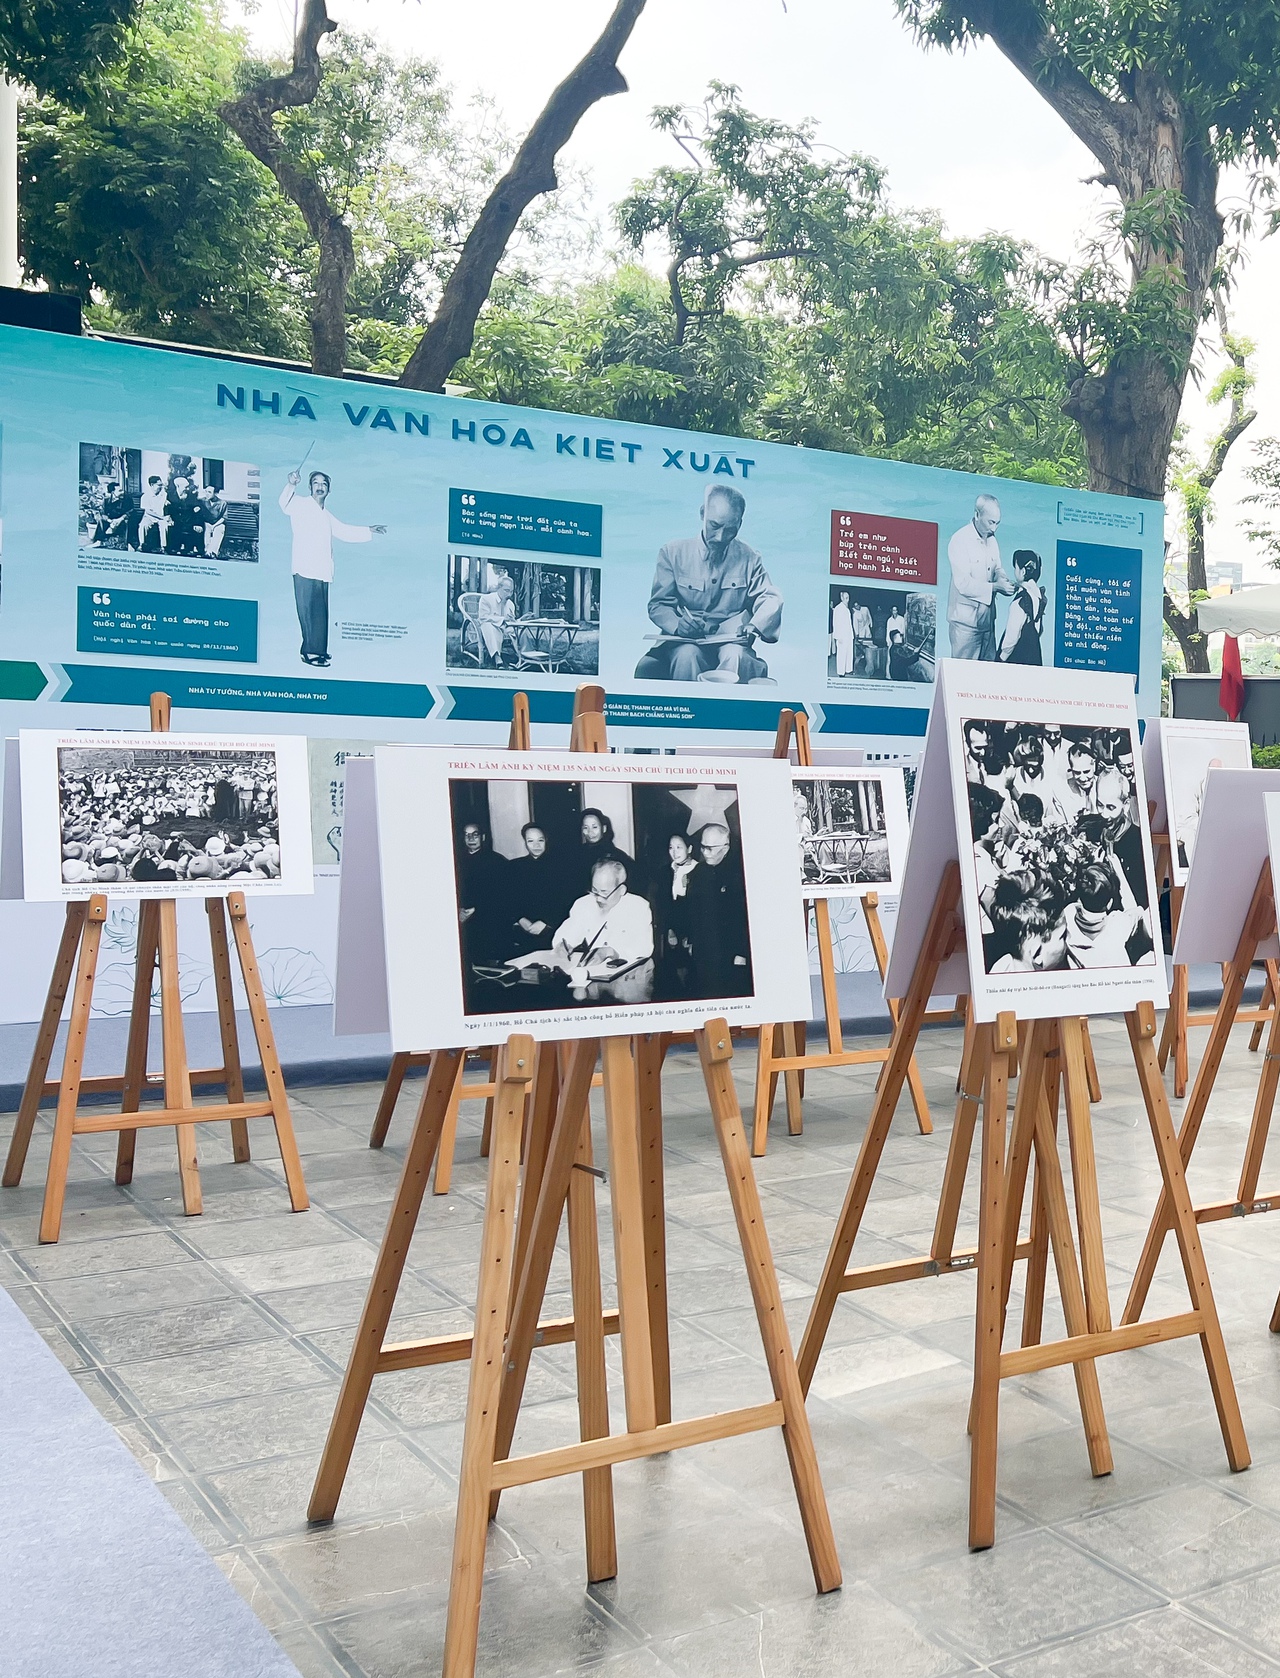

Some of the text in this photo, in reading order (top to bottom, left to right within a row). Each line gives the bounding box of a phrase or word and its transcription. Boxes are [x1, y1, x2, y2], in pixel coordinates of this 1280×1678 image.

[872, 534, 887, 542] như
[840, 540, 900, 554] búp trên cành
[840, 550, 918, 566] Biết ăn ngủ, biết
[839, 561, 853, 570] học
[858, 562, 876, 571] hành
[895, 568, 921, 576] ngoan.
[189, 686, 204, 694] NHÀ
[206, 687, 216, 695] TƯ
[217, 687, 245, 696] TƯỞNG,
[263, 690, 277, 698] VĂN
[278, 691, 295, 699] HÓA,
[479, 762, 498, 770] LÃM
[502, 762, 520, 770] ẢNH
[538, 764, 560, 772] NIỆM
[600, 764, 621, 772] NGÀY
[646, 766, 662, 774] CHỦ
